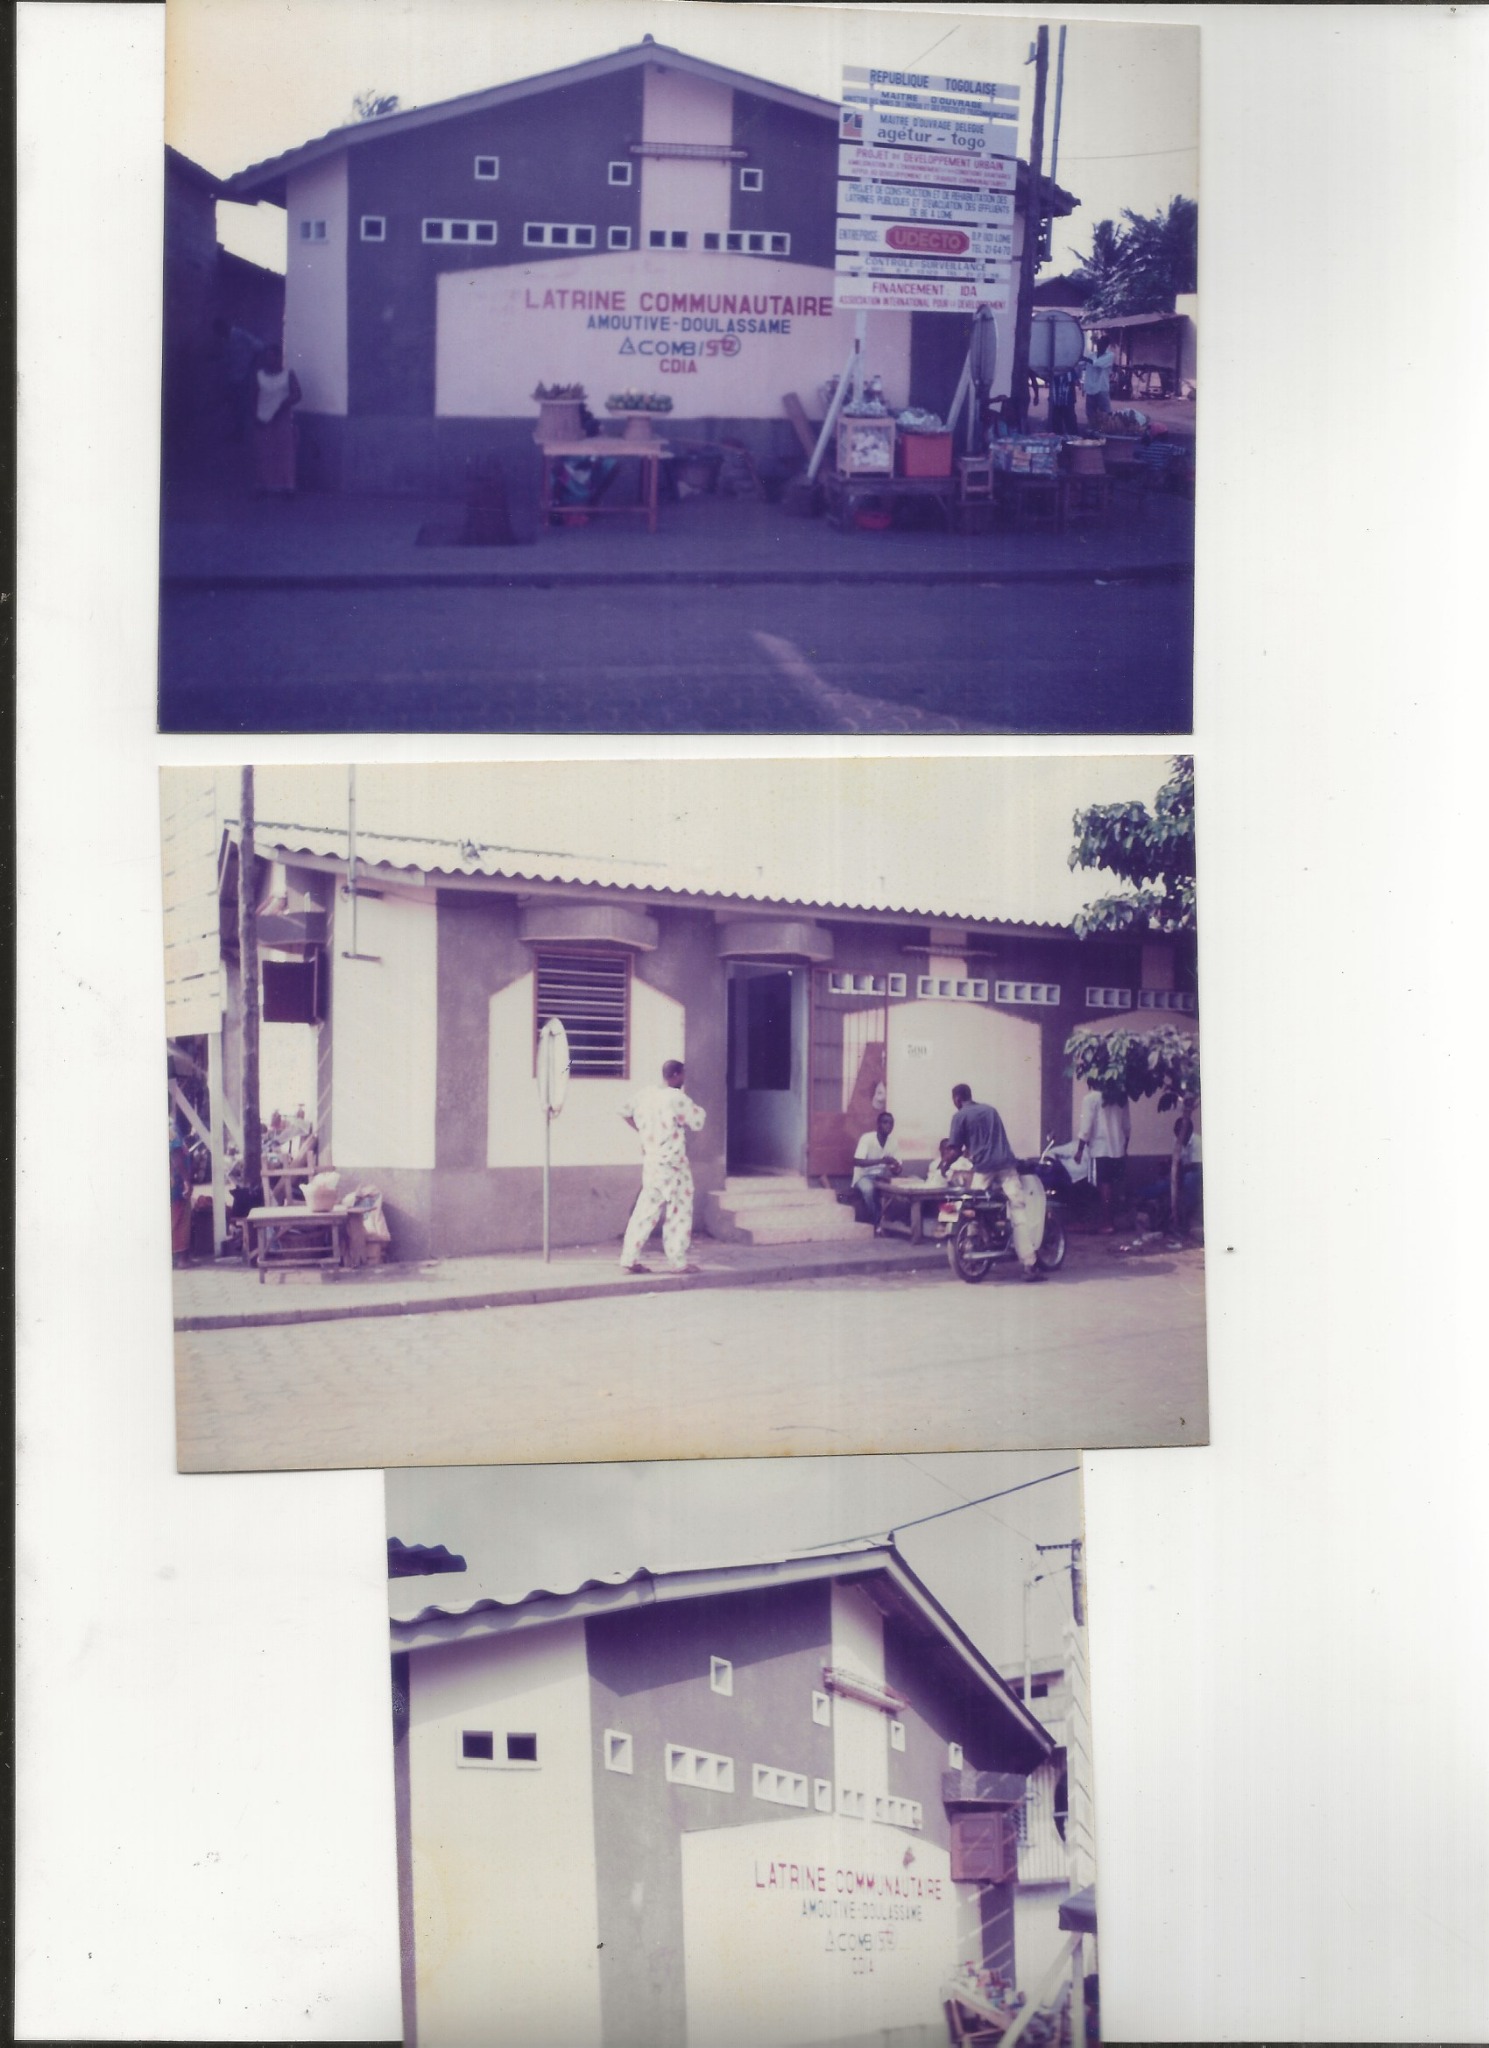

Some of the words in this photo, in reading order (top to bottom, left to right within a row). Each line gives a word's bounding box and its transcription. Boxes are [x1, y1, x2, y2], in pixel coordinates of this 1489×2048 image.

[869, 69, 930, 89] REPUBLIQUE
[944, 77, 997, 96] TOGOLAISE
[880, 114, 909, 127] MAITRE
[951, 133, 986, 150] togo
[904, 152, 970, 168] DEVELOPPEMENT
[974, 160, 1004, 171] URBAIN
[894, 231, 962, 250] UDECTO
[960, 285, 978, 297] IDA
[525, 288, 626, 312] LATRINE
[639, 292, 833, 317] COMMUNAUTAIRE
[586, 314, 792, 335] AMOUTIVE-DOULASSAME
[659, 359, 699, 374] CDIA
